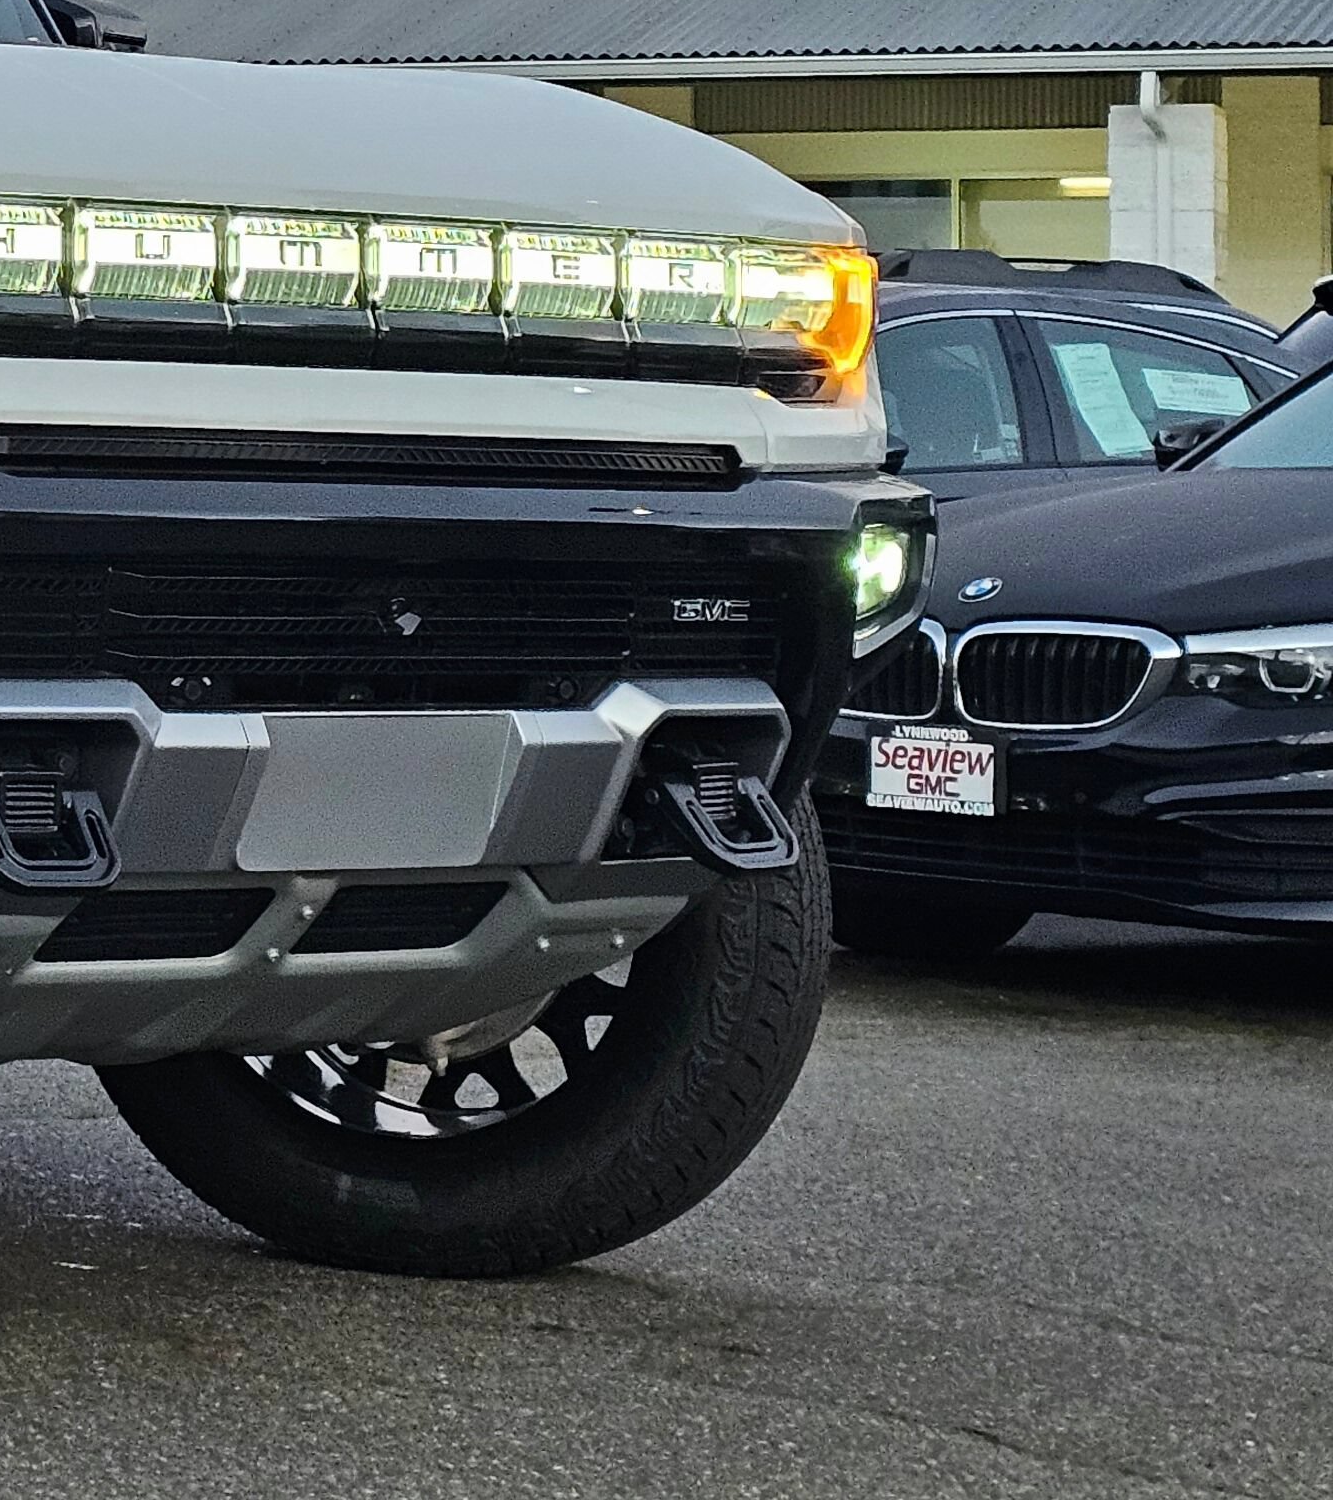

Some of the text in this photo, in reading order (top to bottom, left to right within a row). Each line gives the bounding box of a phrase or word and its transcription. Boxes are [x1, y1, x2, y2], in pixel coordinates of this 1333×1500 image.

[671, 598, 750, 621] GMC
[874, 739, 994, 776] Seaview
[907, 773, 960, 798] GMC
